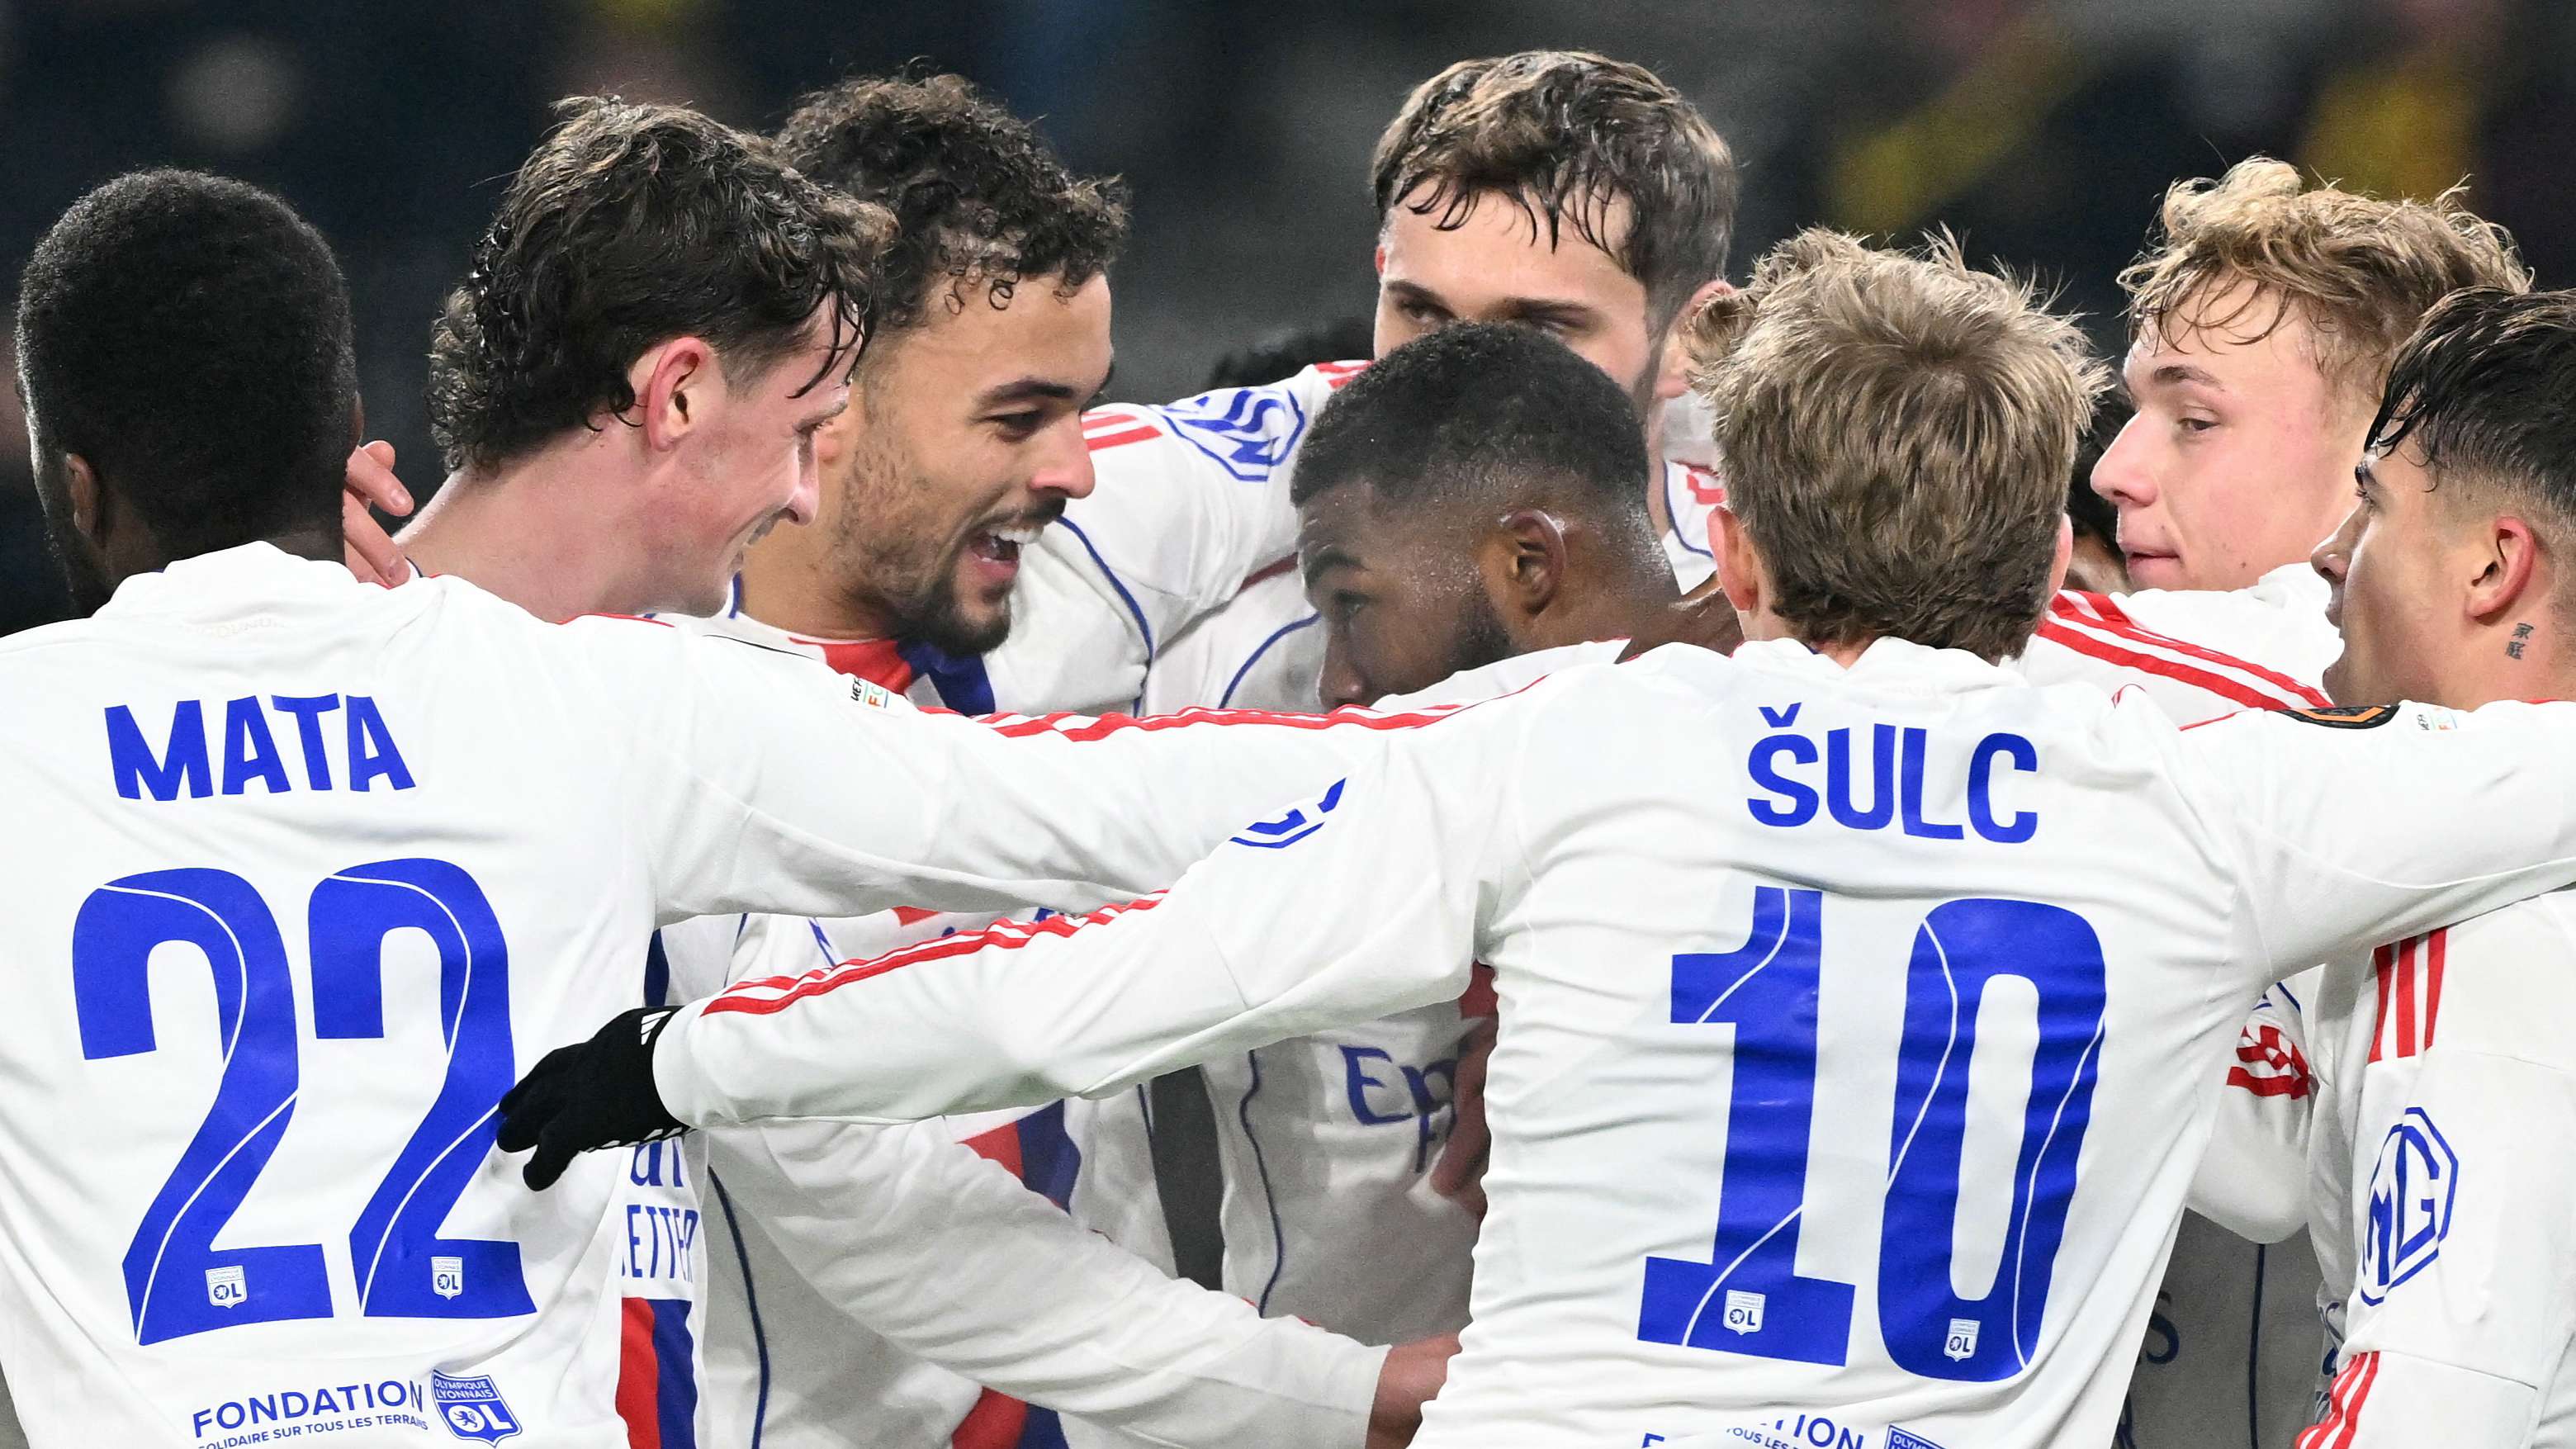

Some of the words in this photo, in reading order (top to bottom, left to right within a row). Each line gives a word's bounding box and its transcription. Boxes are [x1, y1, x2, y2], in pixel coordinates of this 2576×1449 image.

[850, 677, 864, 702] UEF
[105, 693, 416, 802] MATA
[1747, 703, 2038, 845] ŠULC
[73, 858, 537, 1347] 22
[1638, 887, 2107, 1383] 10
[2367, 1125, 2440, 1286] MG
[622, 1205, 698, 1283] ETTER
[214, 1283, 242, 1300] OL
[1730, 1309, 1756, 1326] OL
[434, 1377, 490, 1390] OLYMPIQUE
[436, 1389, 494, 1399] LYONNAIS
[193, 1380, 424, 1437] FONDATION
[448, 1404, 514, 1432] OL
[198, 1432, 270, 1449] OLIDAIRE
[273, 1426, 301, 1438] SUR
[305, 1421, 343, 1433] TOUS
[348, 1418, 372, 1428] LES
[1726, 1428, 1762, 1443] OUS
